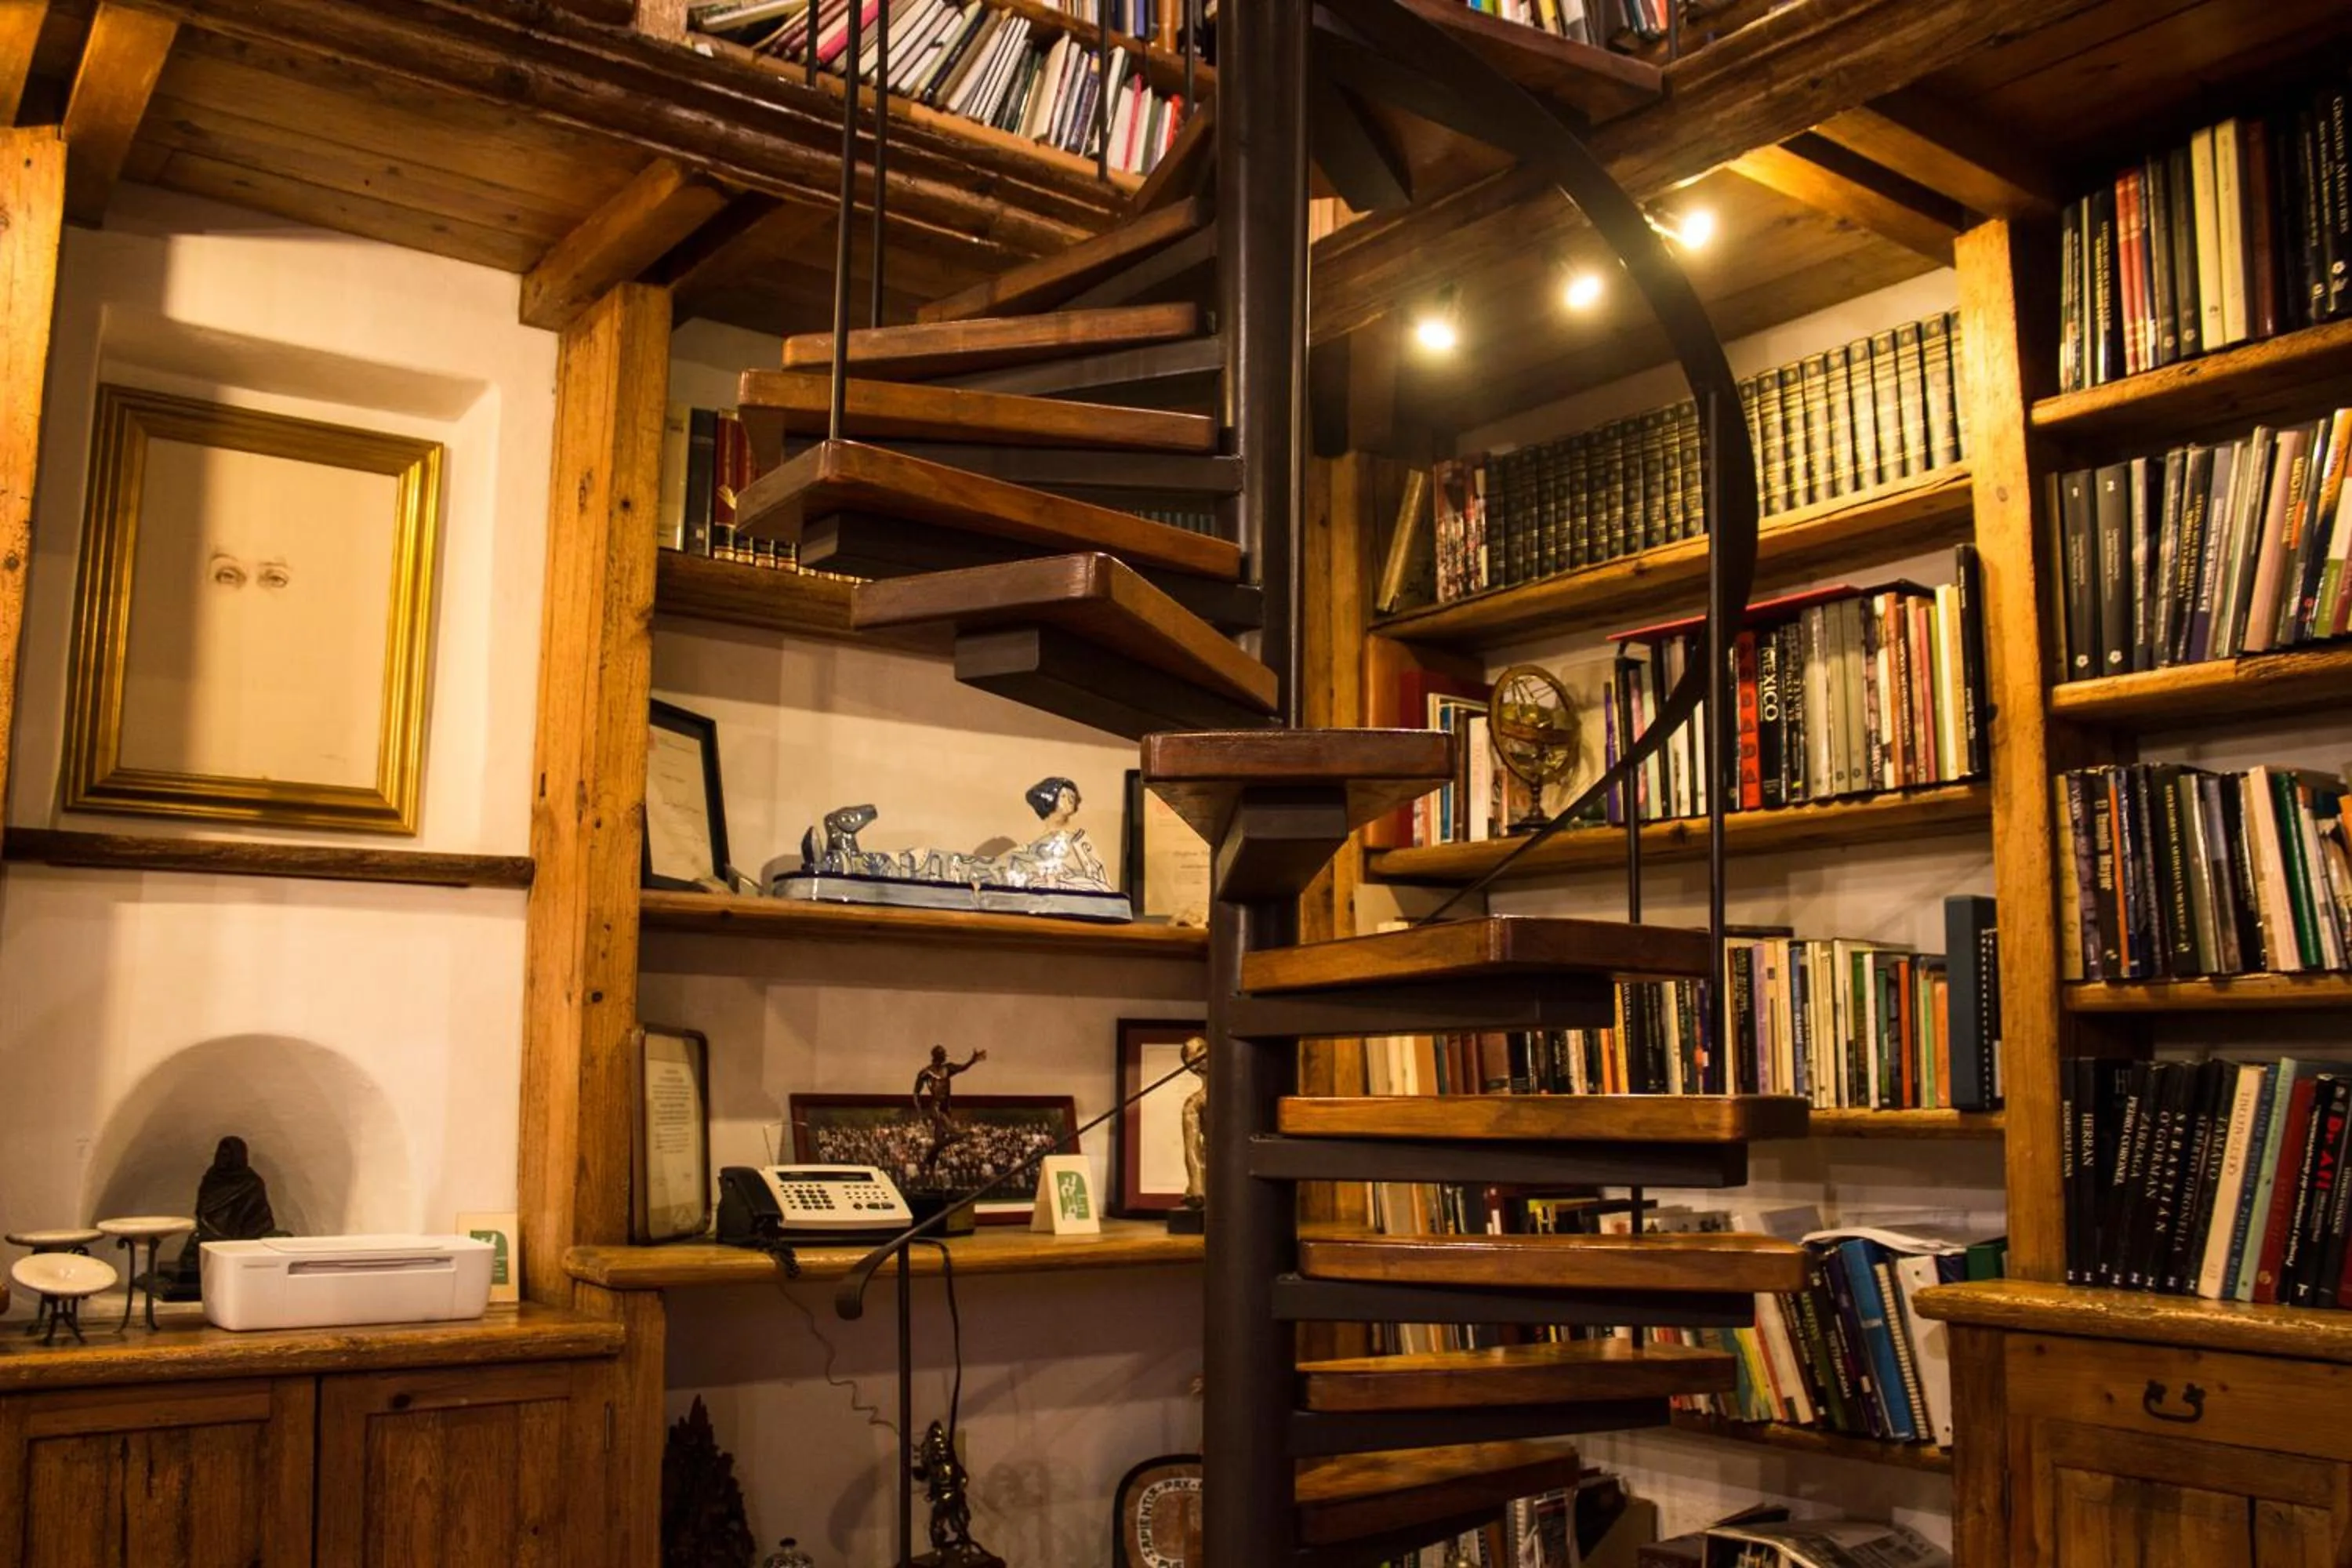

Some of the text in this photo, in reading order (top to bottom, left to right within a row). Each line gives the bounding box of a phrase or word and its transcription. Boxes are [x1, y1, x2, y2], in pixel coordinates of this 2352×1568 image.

[1762, 648, 1780, 722] MEXICO
[2098, 854, 2114, 891] Mayor
[2122, 1095, 2139, 1134] PEDRO
[2113, 1134, 2132, 1186] CORONEL
[2145, 1110, 2169, 1200] O'GORMAN
[2208, 1114, 2229, 1182] TAMAYO
